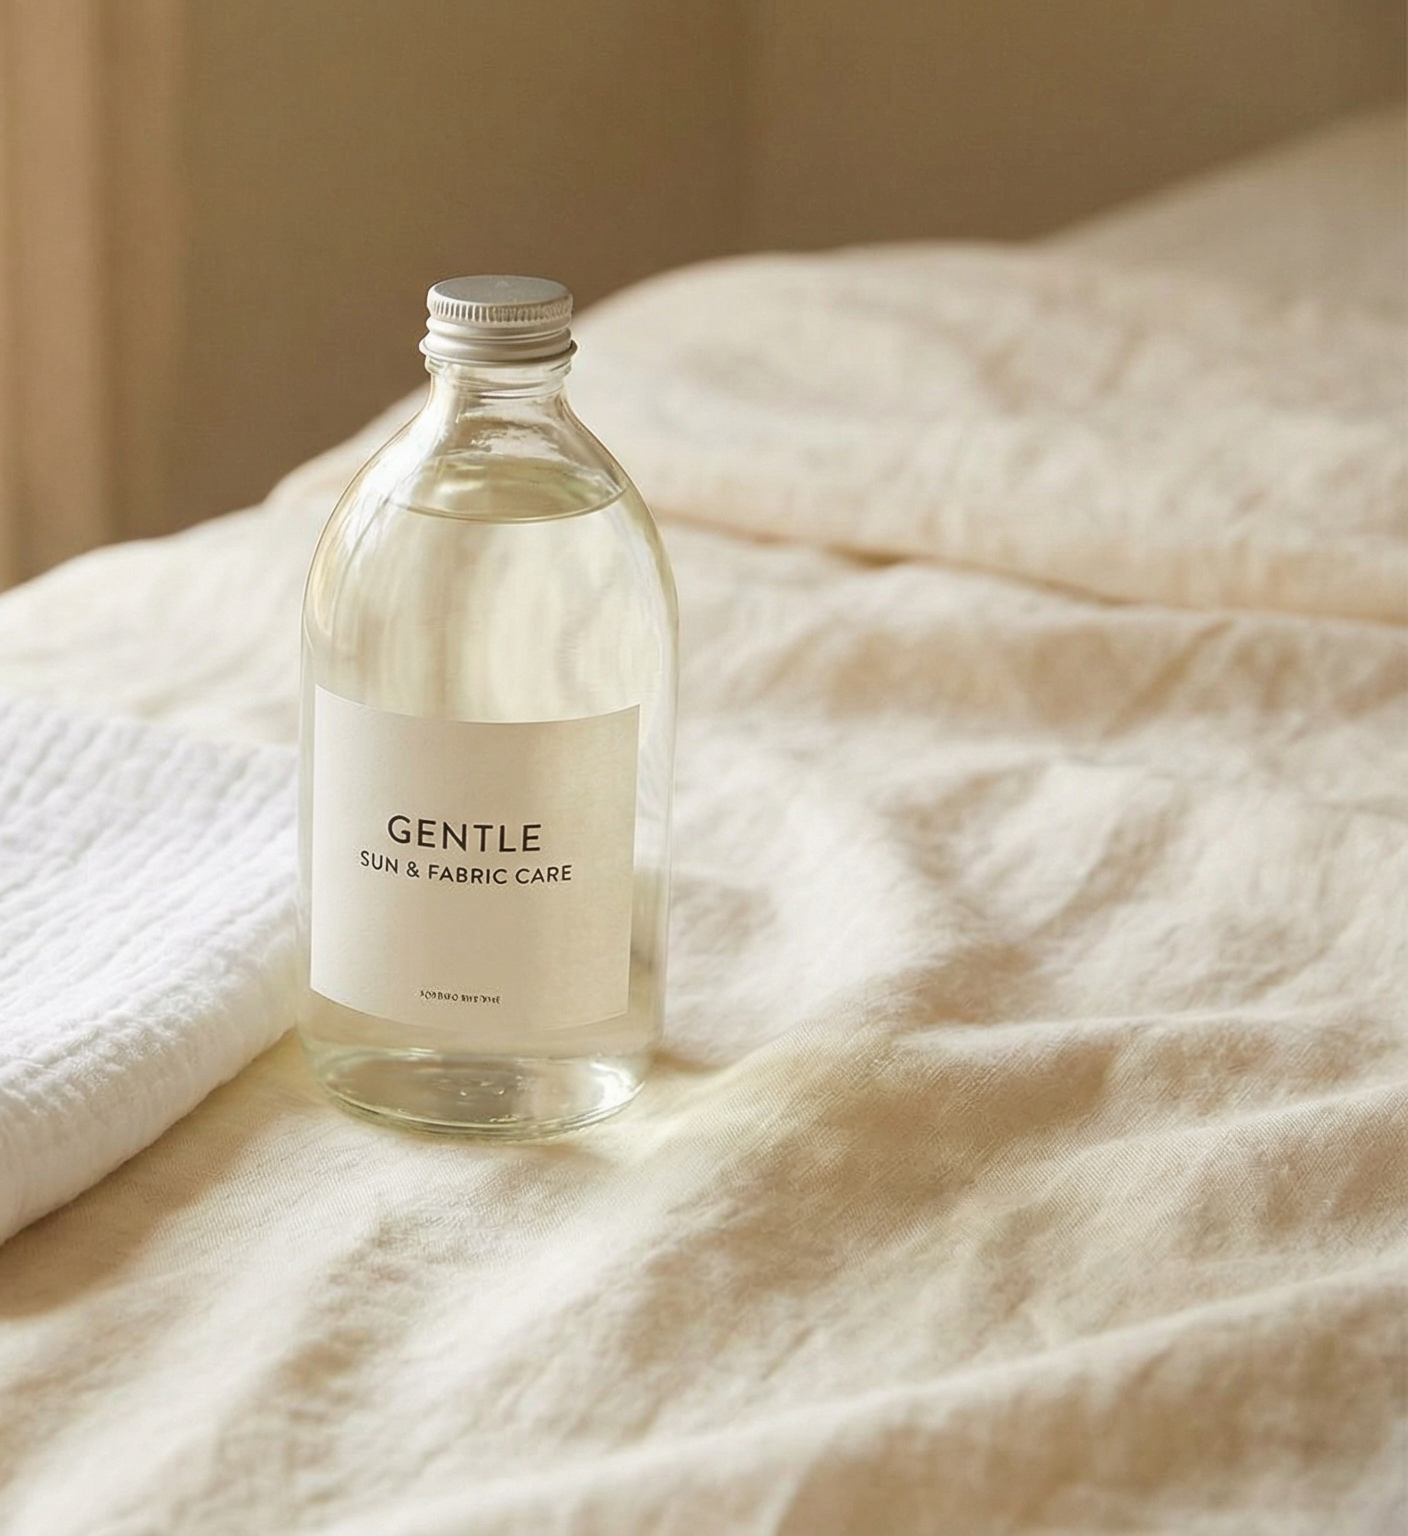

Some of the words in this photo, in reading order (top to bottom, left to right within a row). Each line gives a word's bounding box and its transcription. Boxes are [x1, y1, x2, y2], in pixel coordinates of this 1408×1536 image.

[387, 814, 542, 853] GENTLE
[359, 850, 399, 875] SUN
[406, 860, 420, 879] &
[428, 863, 508, 885] FABRIC
[514, 864, 572, 885] CARE
